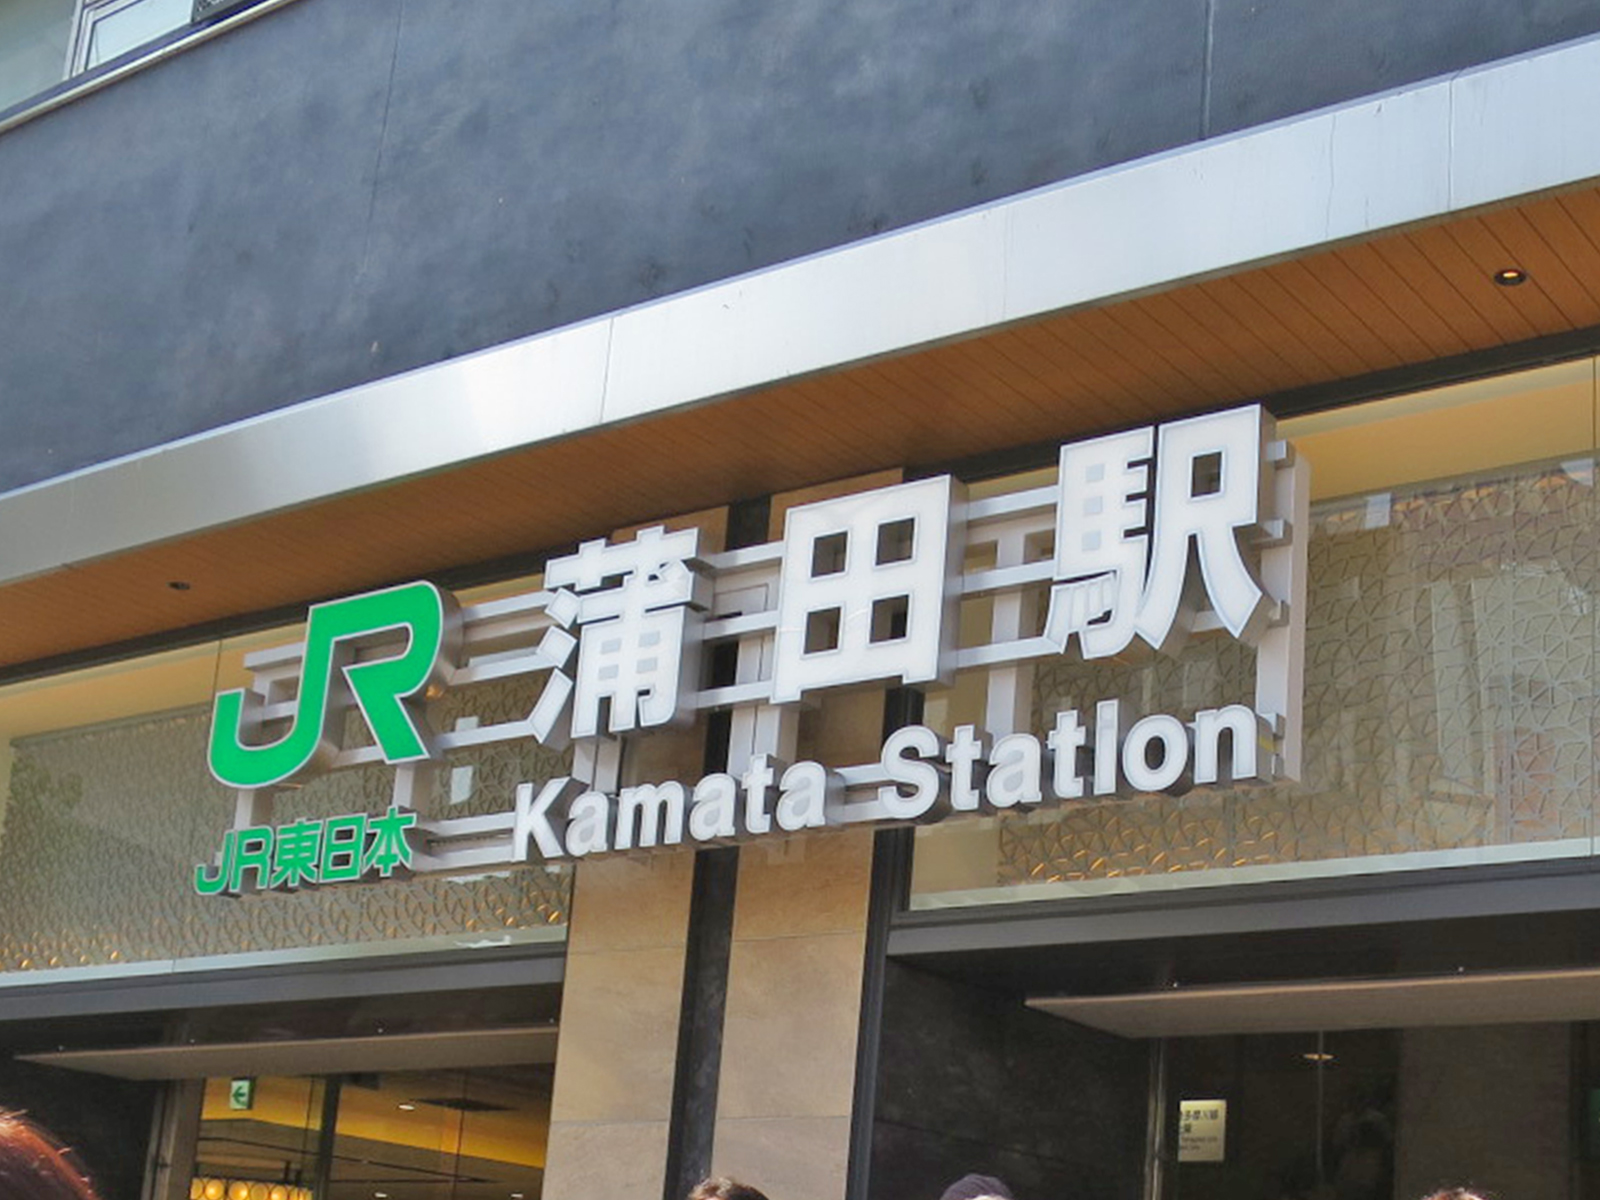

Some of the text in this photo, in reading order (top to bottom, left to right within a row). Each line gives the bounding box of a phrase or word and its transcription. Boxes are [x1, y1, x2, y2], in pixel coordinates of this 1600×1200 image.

[529, 403, 1263, 744] 蒲田駅
[207, 580, 445, 789] JR
[194, 806, 417, 895] JR東日本
[511, 699, 1259, 862] Kamata Station
